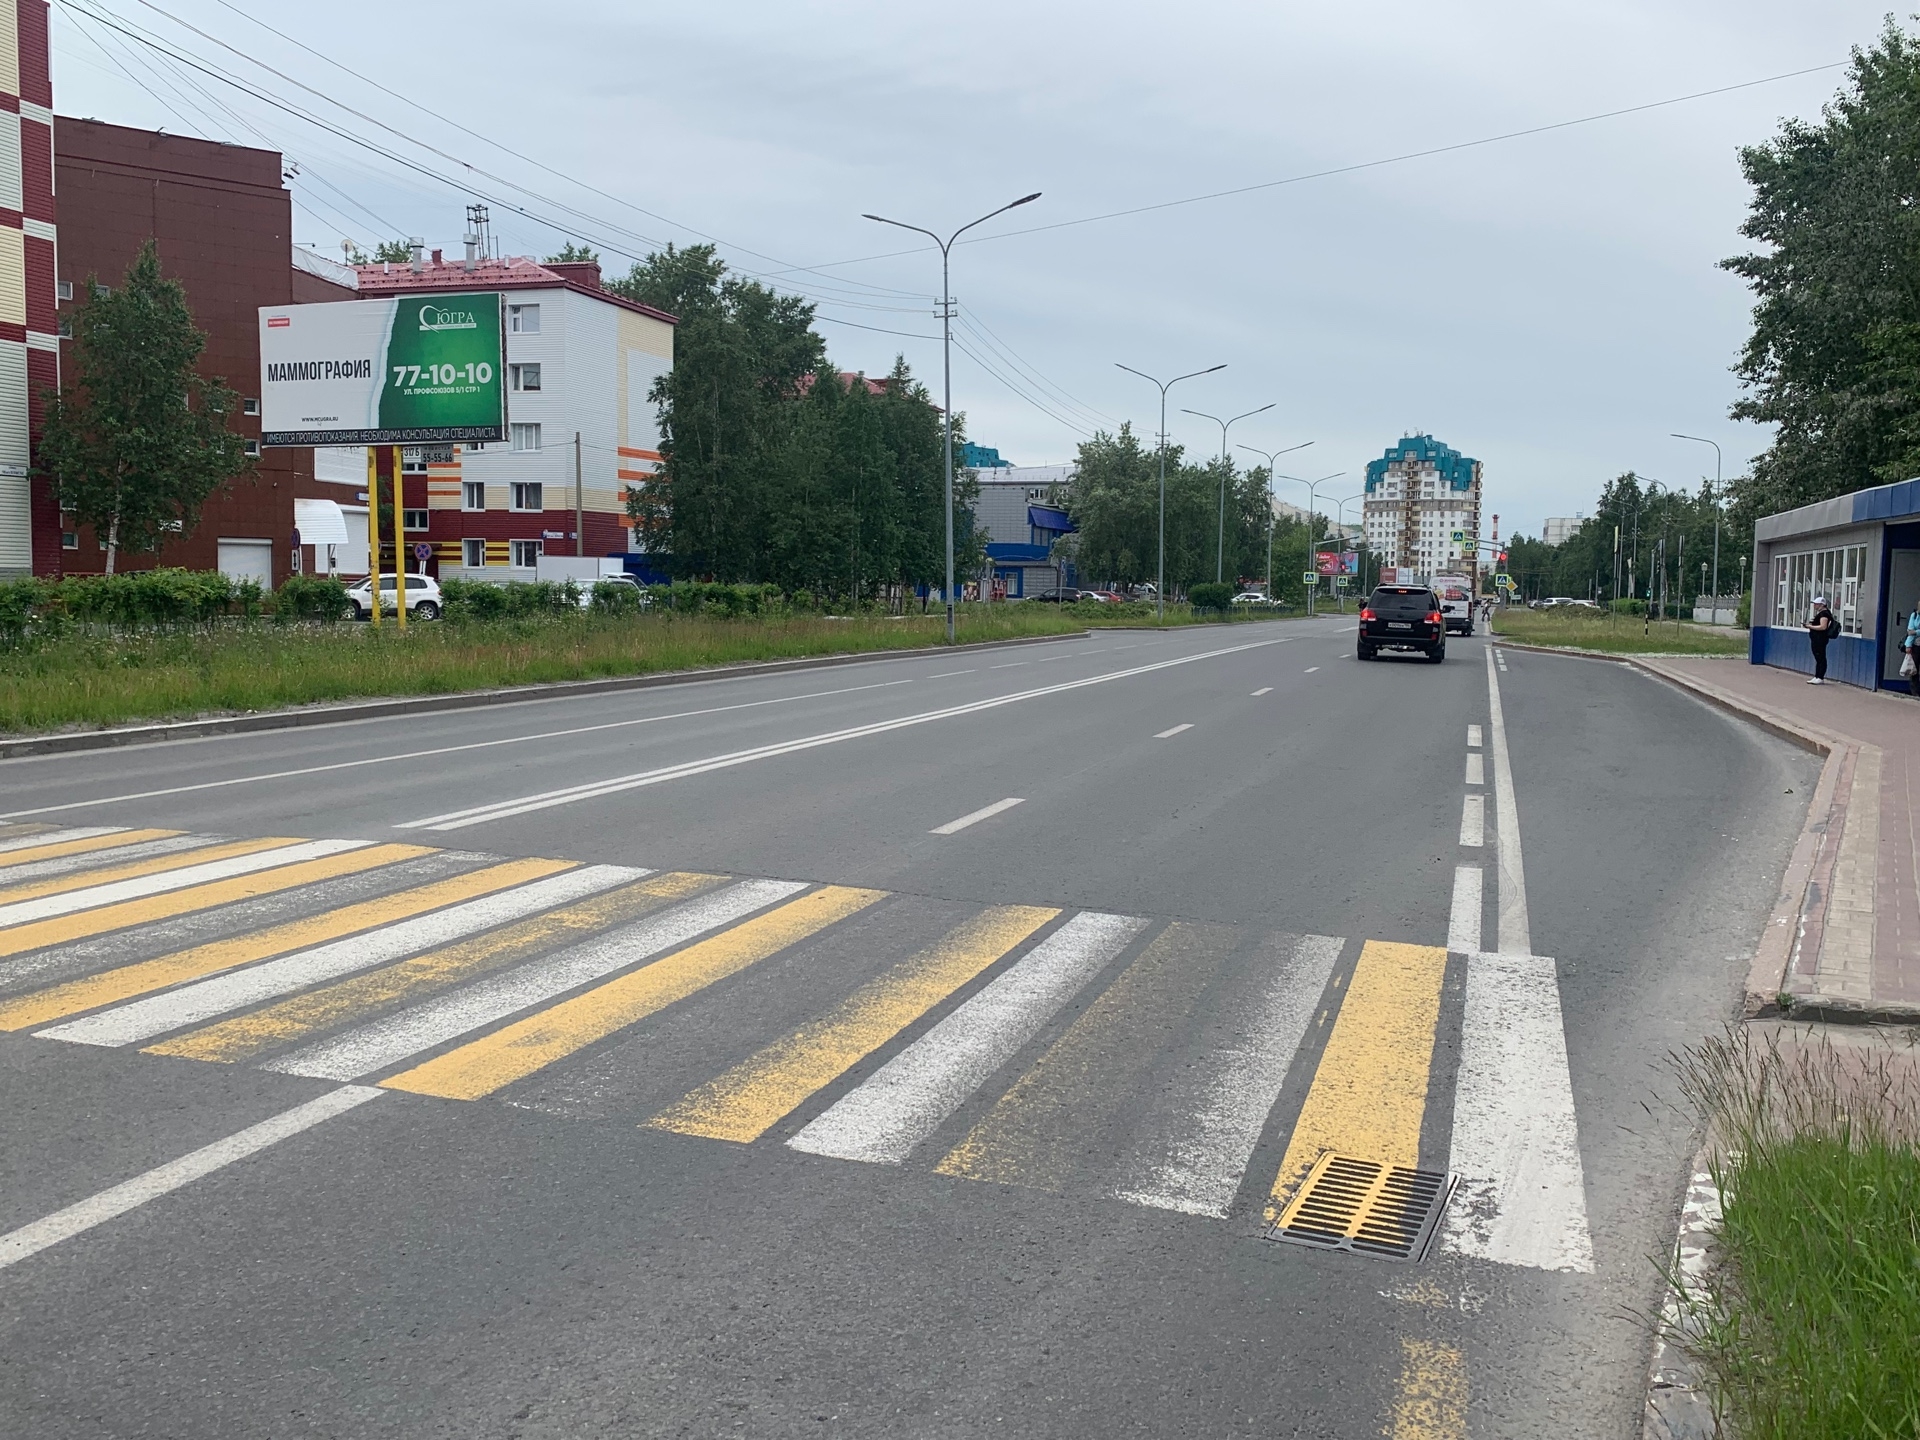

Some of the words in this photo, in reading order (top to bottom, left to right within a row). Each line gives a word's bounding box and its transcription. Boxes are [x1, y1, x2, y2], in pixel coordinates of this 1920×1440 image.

[436, 311, 475, 325] ЮГРА
[267, 358, 371, 382] МАММОГРАФИЯ
[393, 362, 492, 387] 77-10-10
[413, 387, 455, 395] ПРОФСОЮЗОВ
[455, 386, 464, 394] 5/1
[266, 434, 295, 443] ИМЕЮТСЯ
[360, 430, 401, 442] НЕОБХОДИМА
[402, 428, 449, 440] КОНСУЛЬТАЦИЯ
[450, 427, 495, 439] СПЕЦИАЛИСТА
[423, 453, 453, 463] 55-55-66
